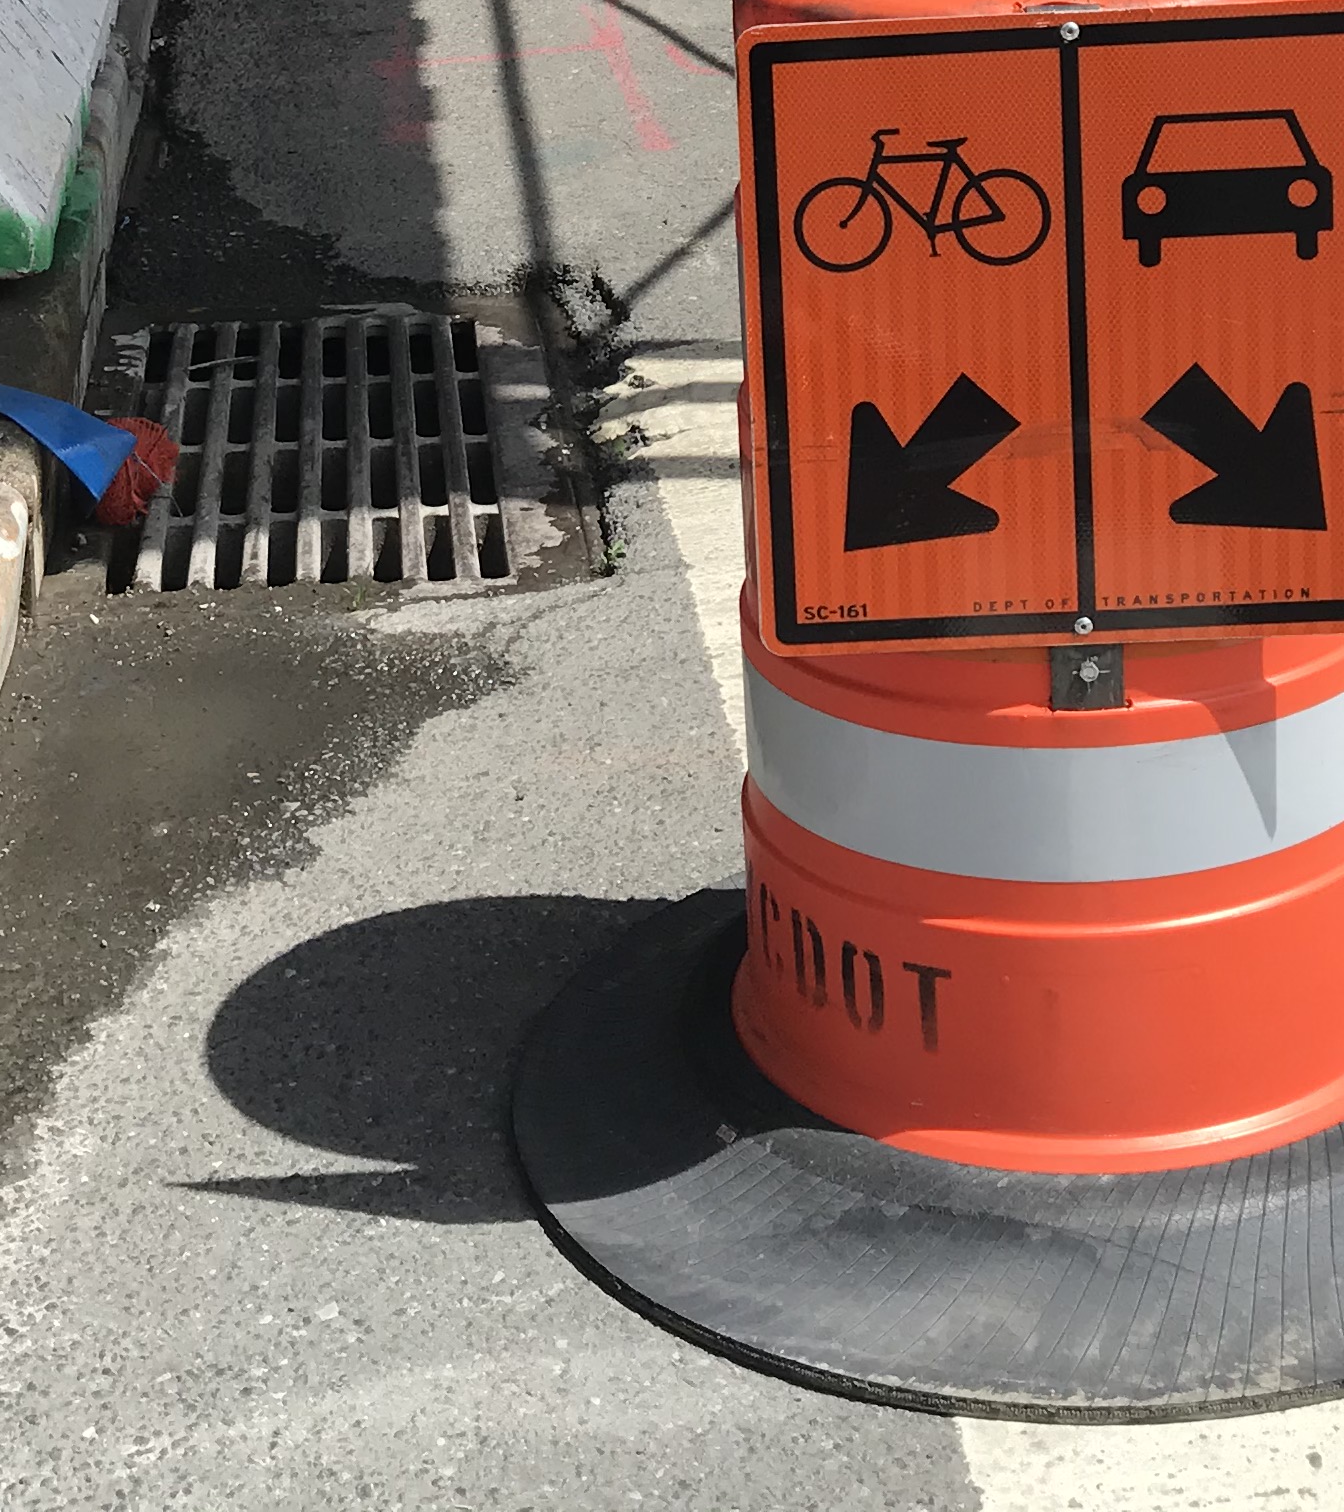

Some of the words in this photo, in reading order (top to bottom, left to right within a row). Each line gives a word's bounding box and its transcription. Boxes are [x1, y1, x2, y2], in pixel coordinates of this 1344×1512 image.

[805, 603, 868, 620] SC-161
[973, 599, 1029, 613] DEPT
[1045, 598, 1070, 610] OF
[1102, 588, 1311, 607] TRANSPORTATION
